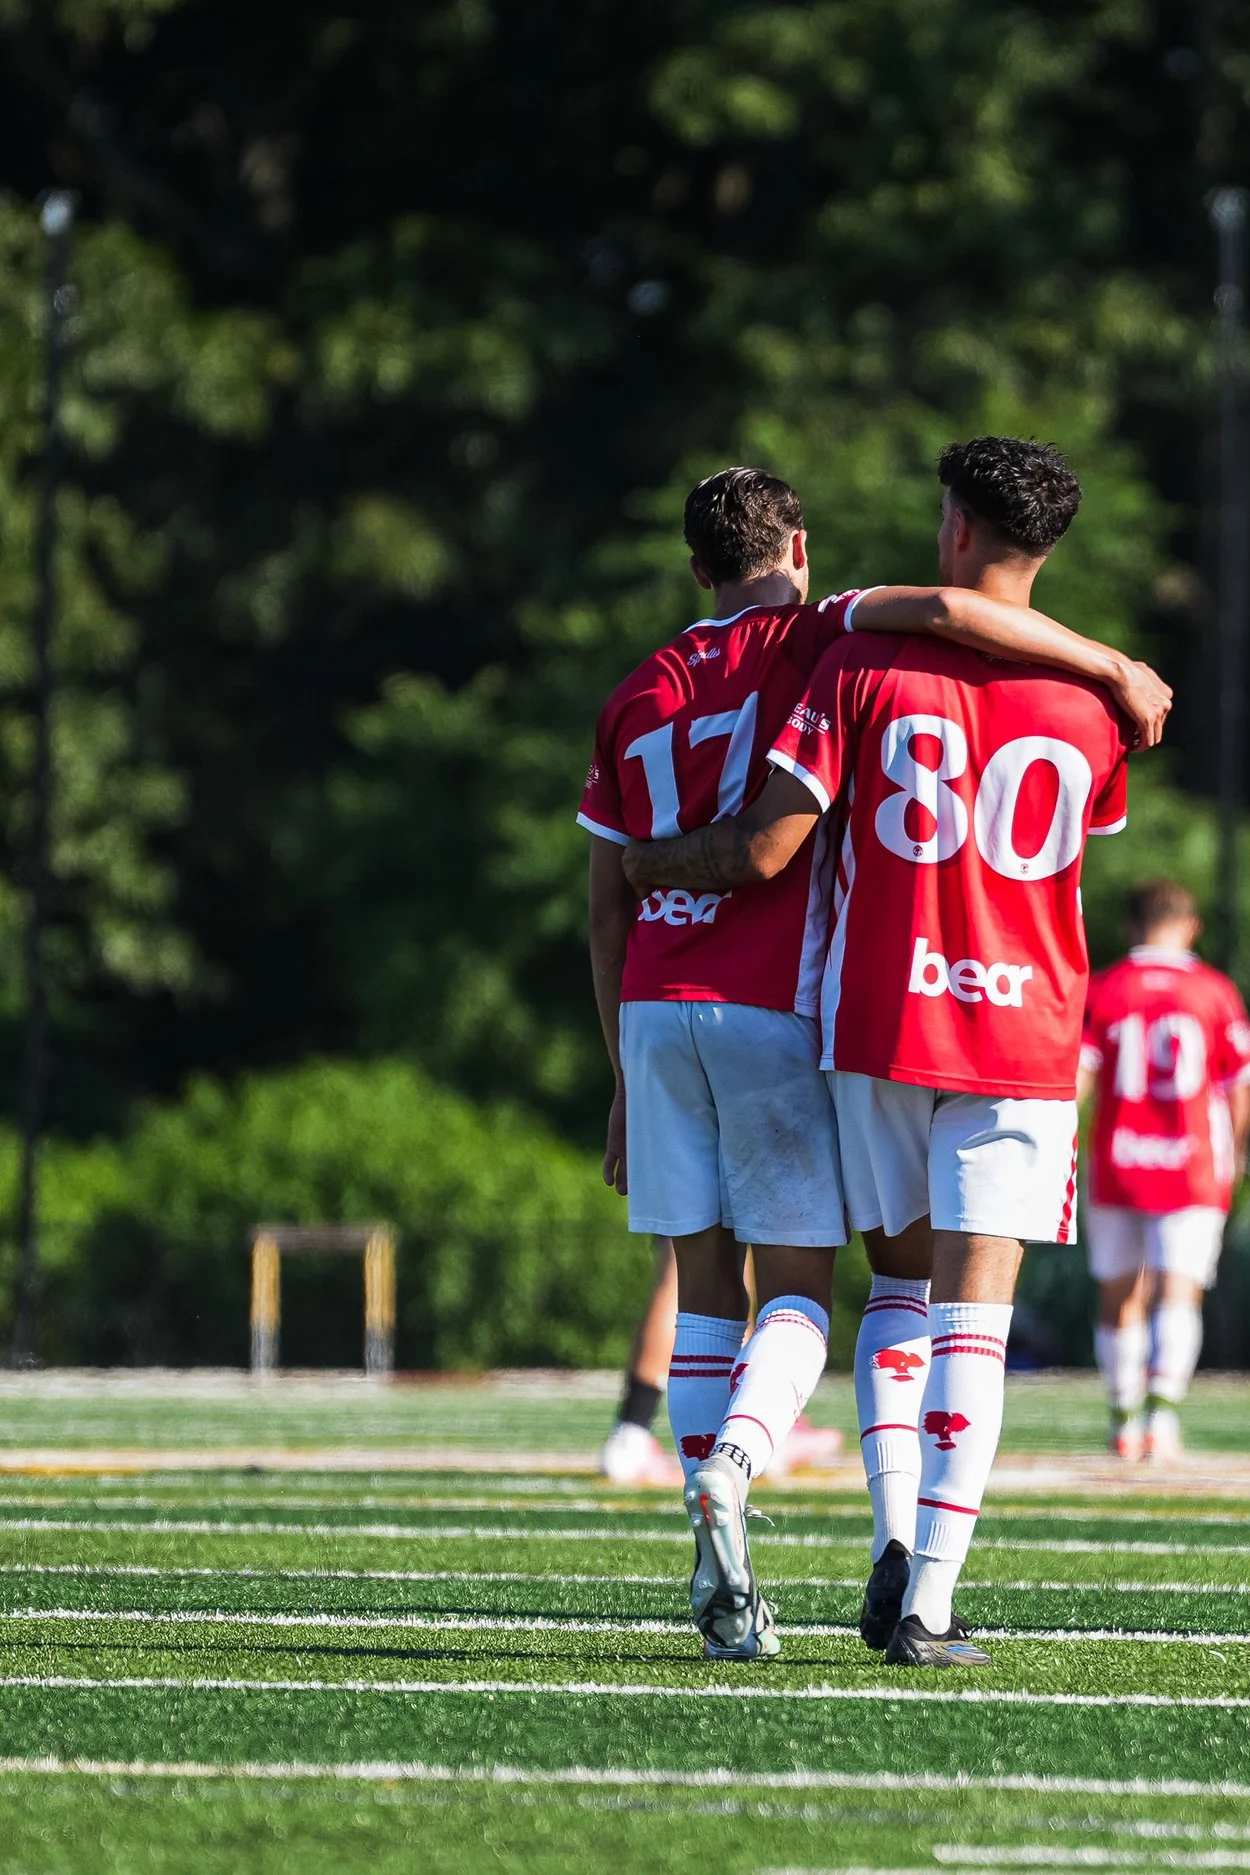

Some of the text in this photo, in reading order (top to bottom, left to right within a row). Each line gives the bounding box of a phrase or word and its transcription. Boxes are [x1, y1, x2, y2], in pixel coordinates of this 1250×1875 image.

[624, 691, 759, 840] 17
[875, 714, 1093, 882] 80
[907, 937, 1033, 1008] bear
[1106, 1012, 1206, 1102] 19
